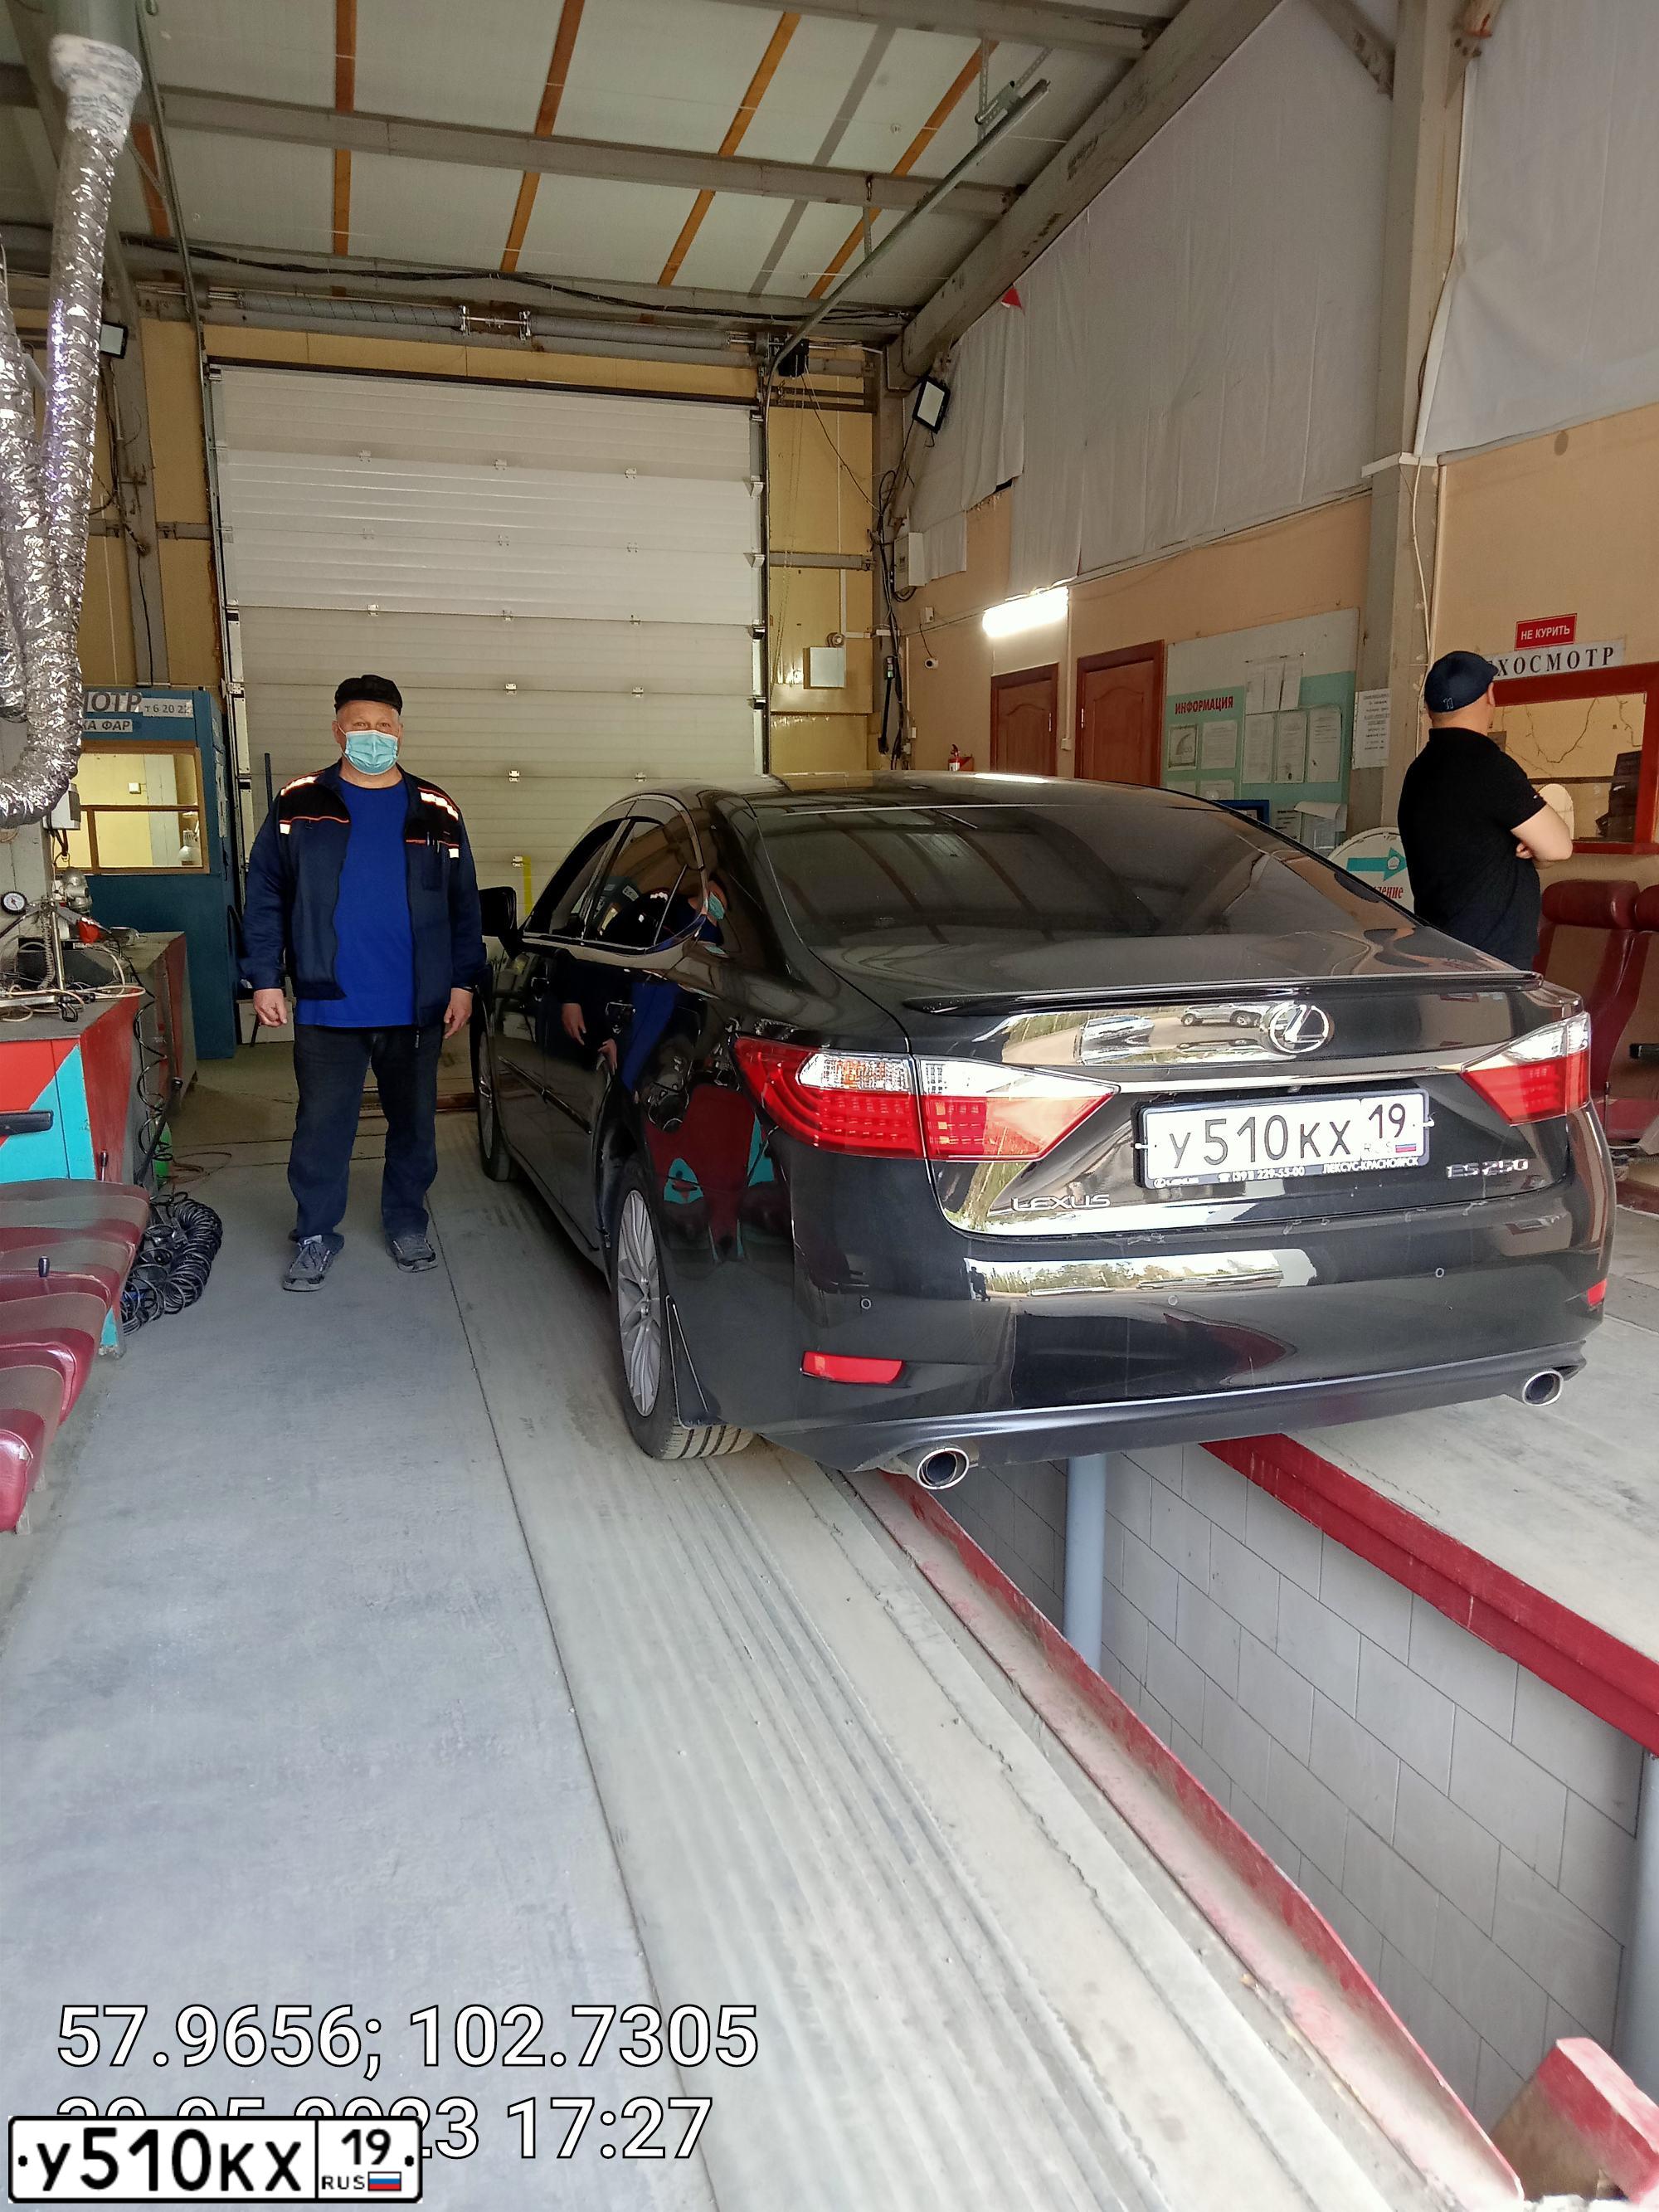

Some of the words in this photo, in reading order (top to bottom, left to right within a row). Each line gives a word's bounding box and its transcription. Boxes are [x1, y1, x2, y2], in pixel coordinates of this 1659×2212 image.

[1520, 630, 1533, 641] НЕ
[1535, 625, 1570, 639] КУРИТЬ
[1487, 646, 1614, 677] ХОСМОТР
[1175, 695, 1234, 715] ИНФОРМАЦИЯ
[101, 720, 130, 730] ФАР
[1369, 1103, 1406, 1139] 19
[1169, 1114, 1351, 1169] У510КХ
[1364, 1141, 1394, 1154] RS
[1012, 1194, 1111, 1212] LEXUS
